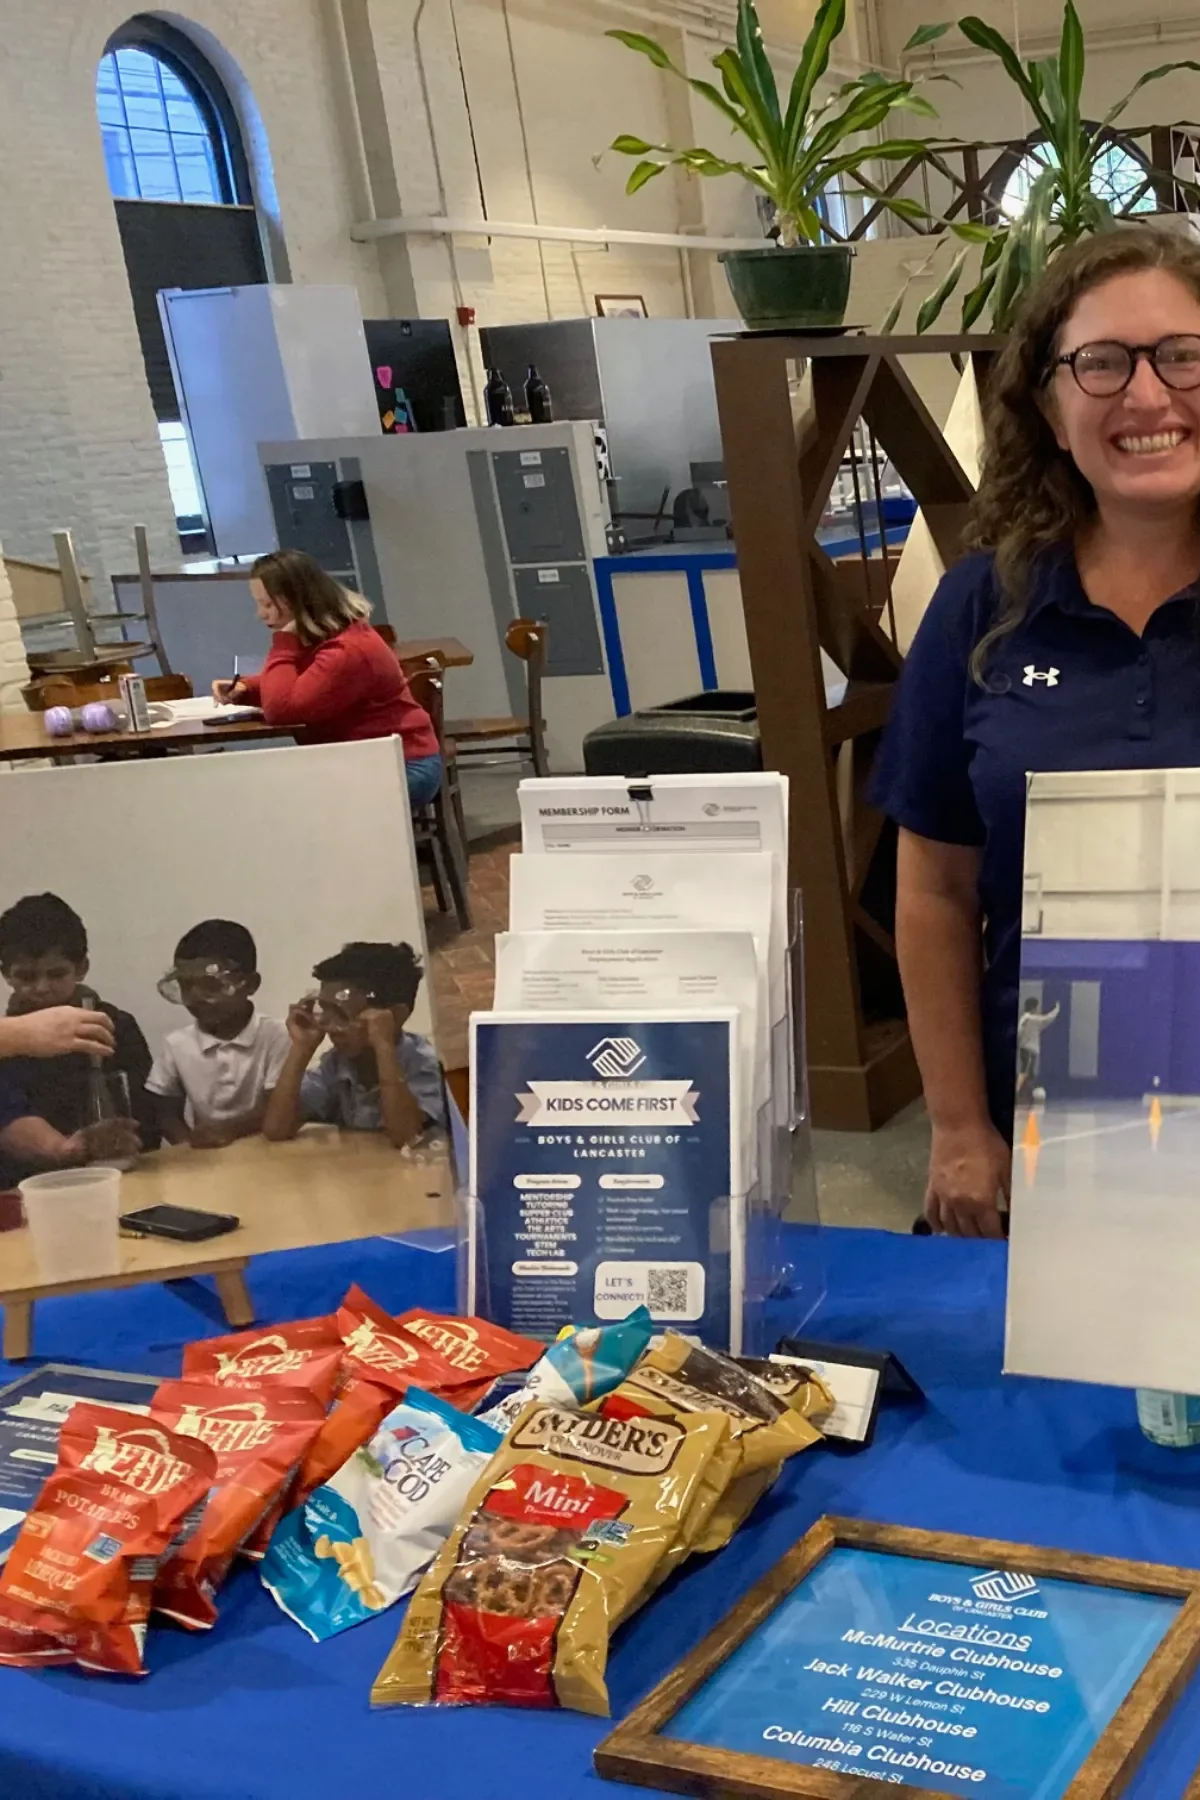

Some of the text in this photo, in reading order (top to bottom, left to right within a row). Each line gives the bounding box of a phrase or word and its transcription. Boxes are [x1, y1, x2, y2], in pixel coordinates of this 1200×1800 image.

[539, 807, 630, 816] MEMBERSHIP FORM
[546, 1097, 677, 1111] KIDS COME FIRST
[537, 1135, 681, 1145] BOYS & GIRLS CLUB OF
[573, 1149, 646, 1158] LANCASTER
[605, 1277, 633, 1287] LET'S
[595, 1293, 645, 1302] CONNECT!
[173, 1402, 285, 1452] KETTLE
[530, 1411, 669, 1458] SNYDER'S
[80, 1427, 192, 1494] KETTLE
[400, 1437, 452, 1484] CAPE
[384, 1459, 430, 1502] COD
[524, 1481, 595, 1513] Mini
[928, 1593, 1048, 1619] BOYS & GIRLS CLUB
[965, 1607, 1014, 1620] LANCASTER
[898, 1613, 1033, 1651] Locations
[841, 1629, 1063, 1678] McMurtrie Clubhouse
[920, 1662, 968, 1678] Dauphin
[970, 1671, 986, 1681] St
[804, 1658, 1051, 1713] Jack Walker Clubhouse
[860, 1688, 966, 1715] 229 W Lemon St
[822, 1696, 977, 1738] Hill Clubhouse
[842, 1722, 933, 1748] 116 S Water St
[763, 1725, 987, 1782] Columbia Clubhouse
[812, 1757, 905, 1784] 248 Locust St
